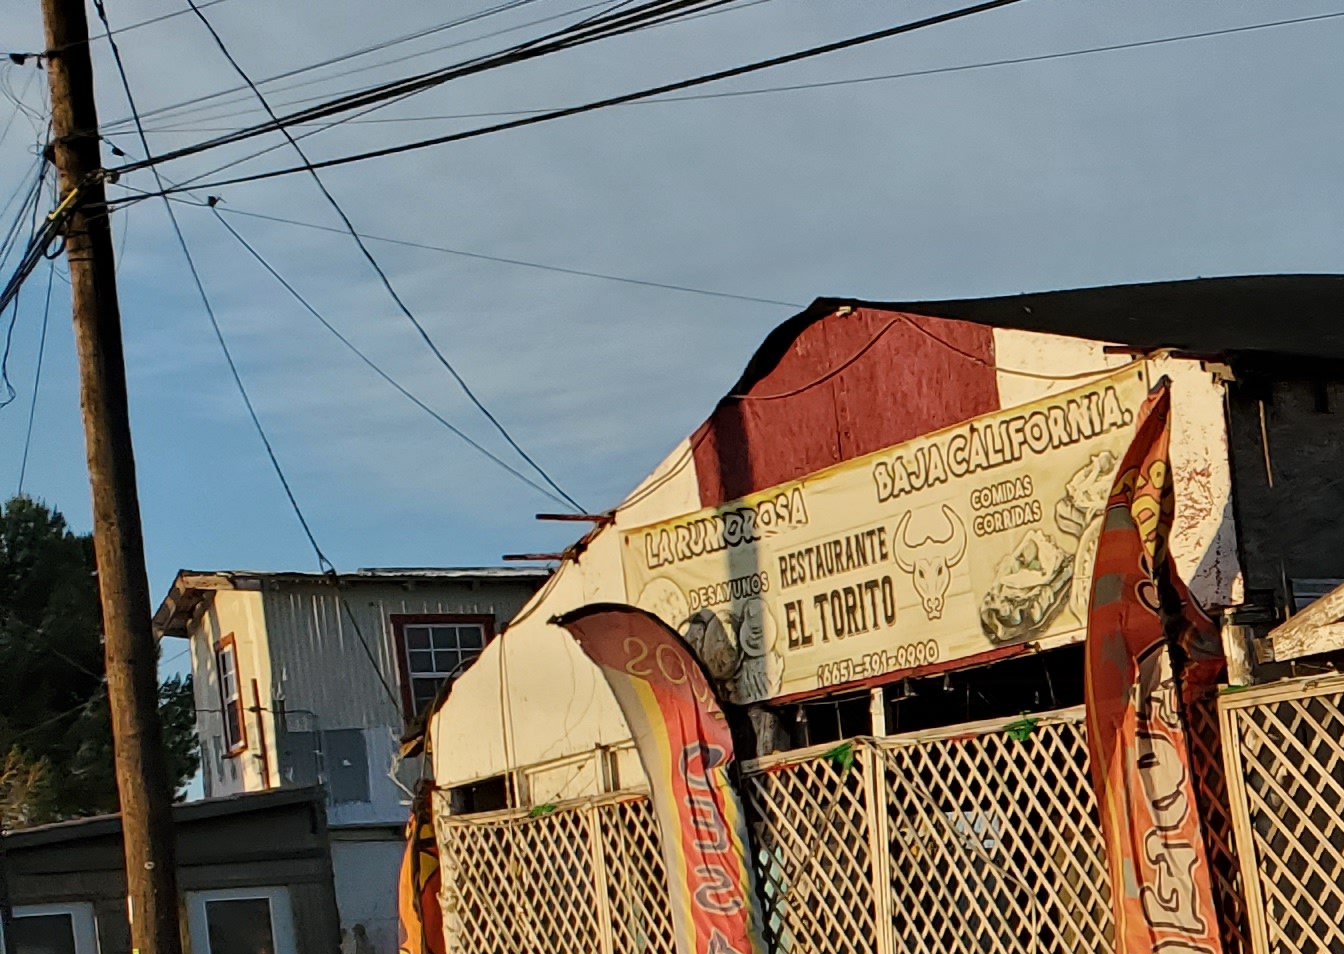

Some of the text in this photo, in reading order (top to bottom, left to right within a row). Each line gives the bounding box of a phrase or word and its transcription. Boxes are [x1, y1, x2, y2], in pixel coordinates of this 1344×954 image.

[645, 386, 1134, 569] LA RUMOROSA BAJA CALIFORNIA.
[970, 475, 1034, 511] COMIDAS
[973, 500, 1042, 537] CORRIDAS
[778, 526, 889, 589] RESTAURANTE
[689, 571, 769, 610] DESAYUNOS
[784, 575, 896, 651] EL TORITO
